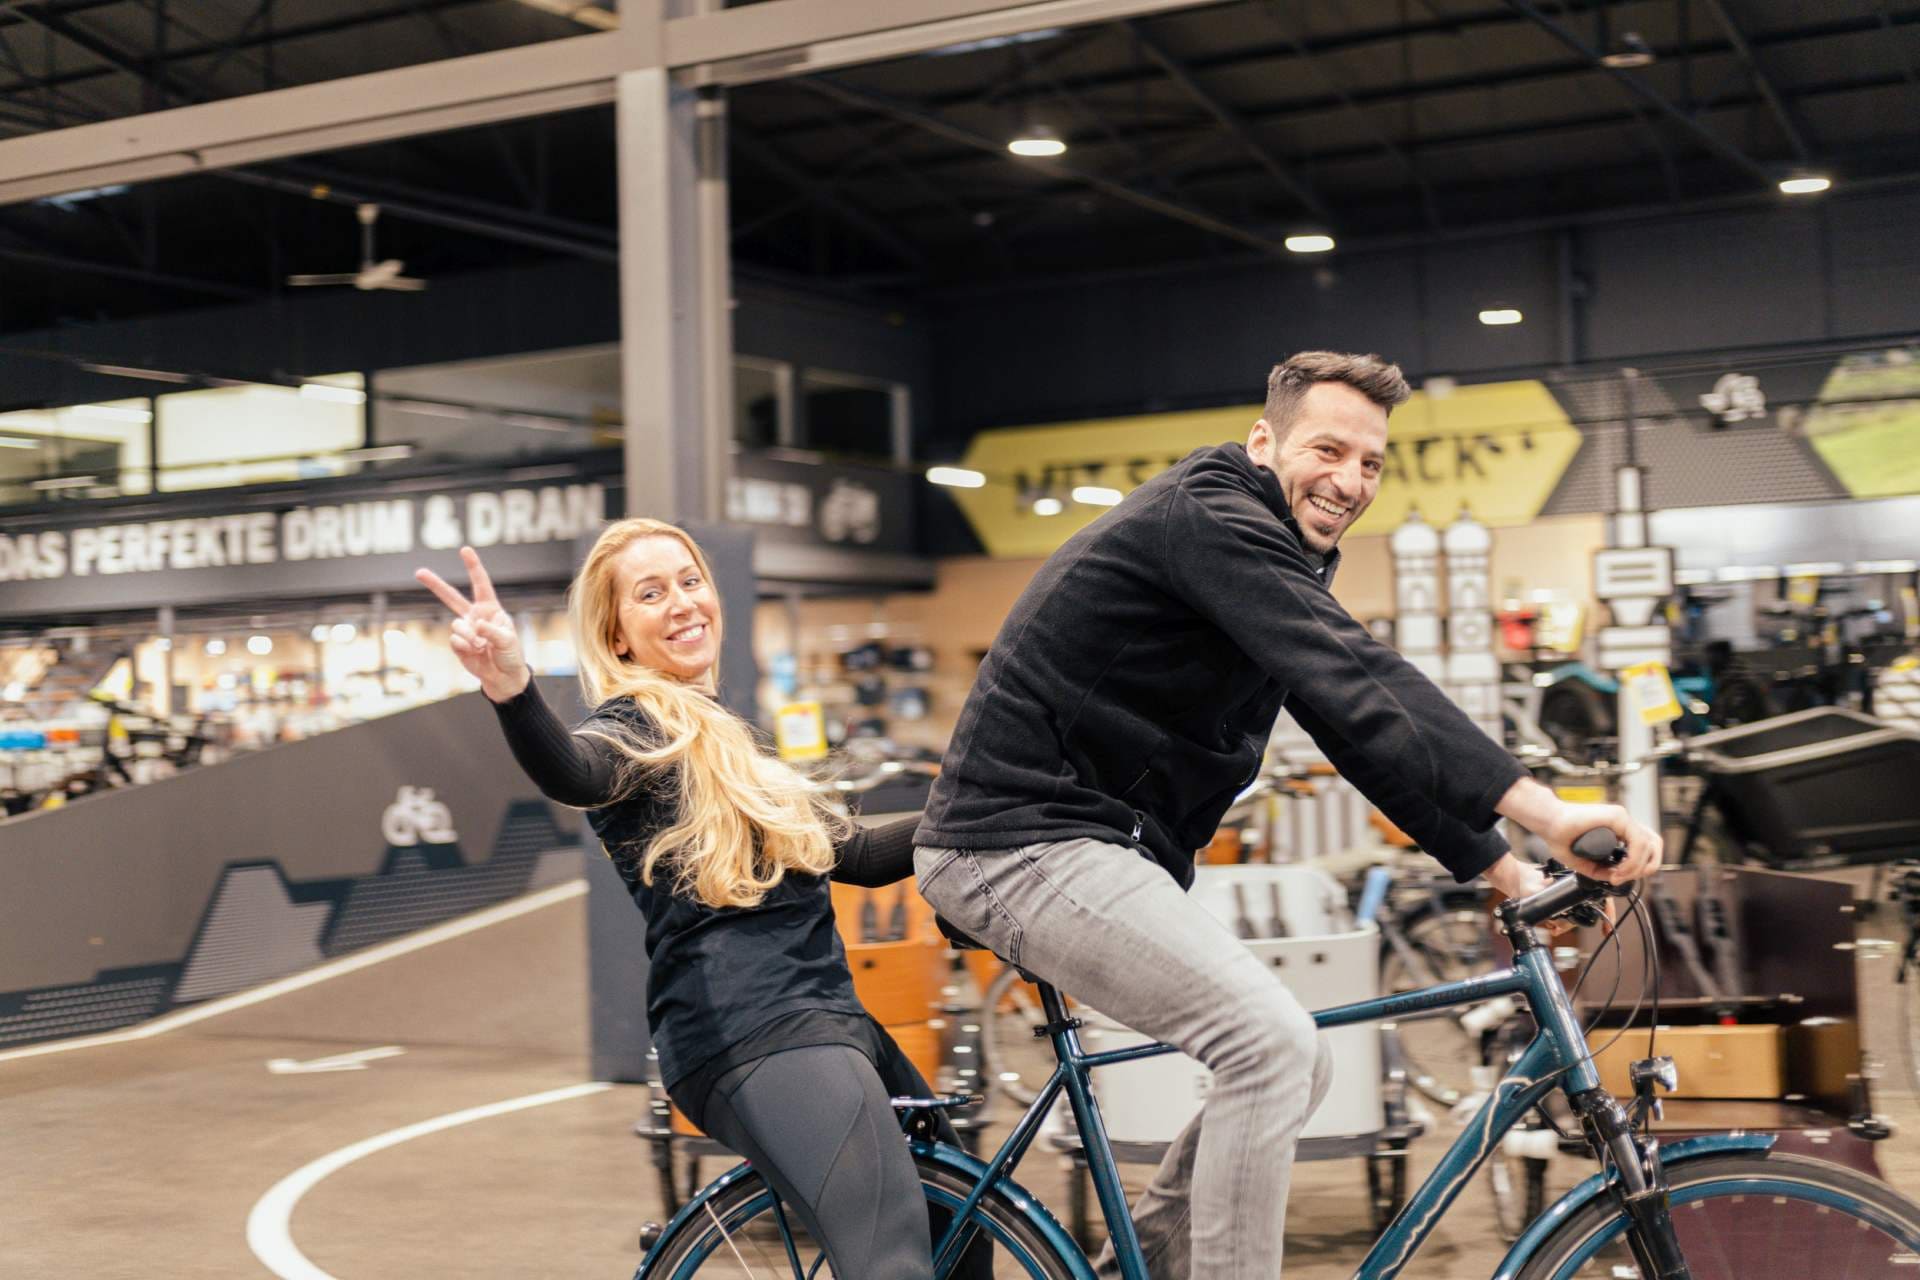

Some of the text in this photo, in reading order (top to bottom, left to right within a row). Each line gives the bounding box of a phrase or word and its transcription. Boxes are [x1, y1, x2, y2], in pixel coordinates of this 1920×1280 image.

[0, 530, 67, 582] DAS
[70, 511, 279, 577] PERFEKTE
[282, 498, 414, 561] DRUM
[420, 495, 464, 550] &
